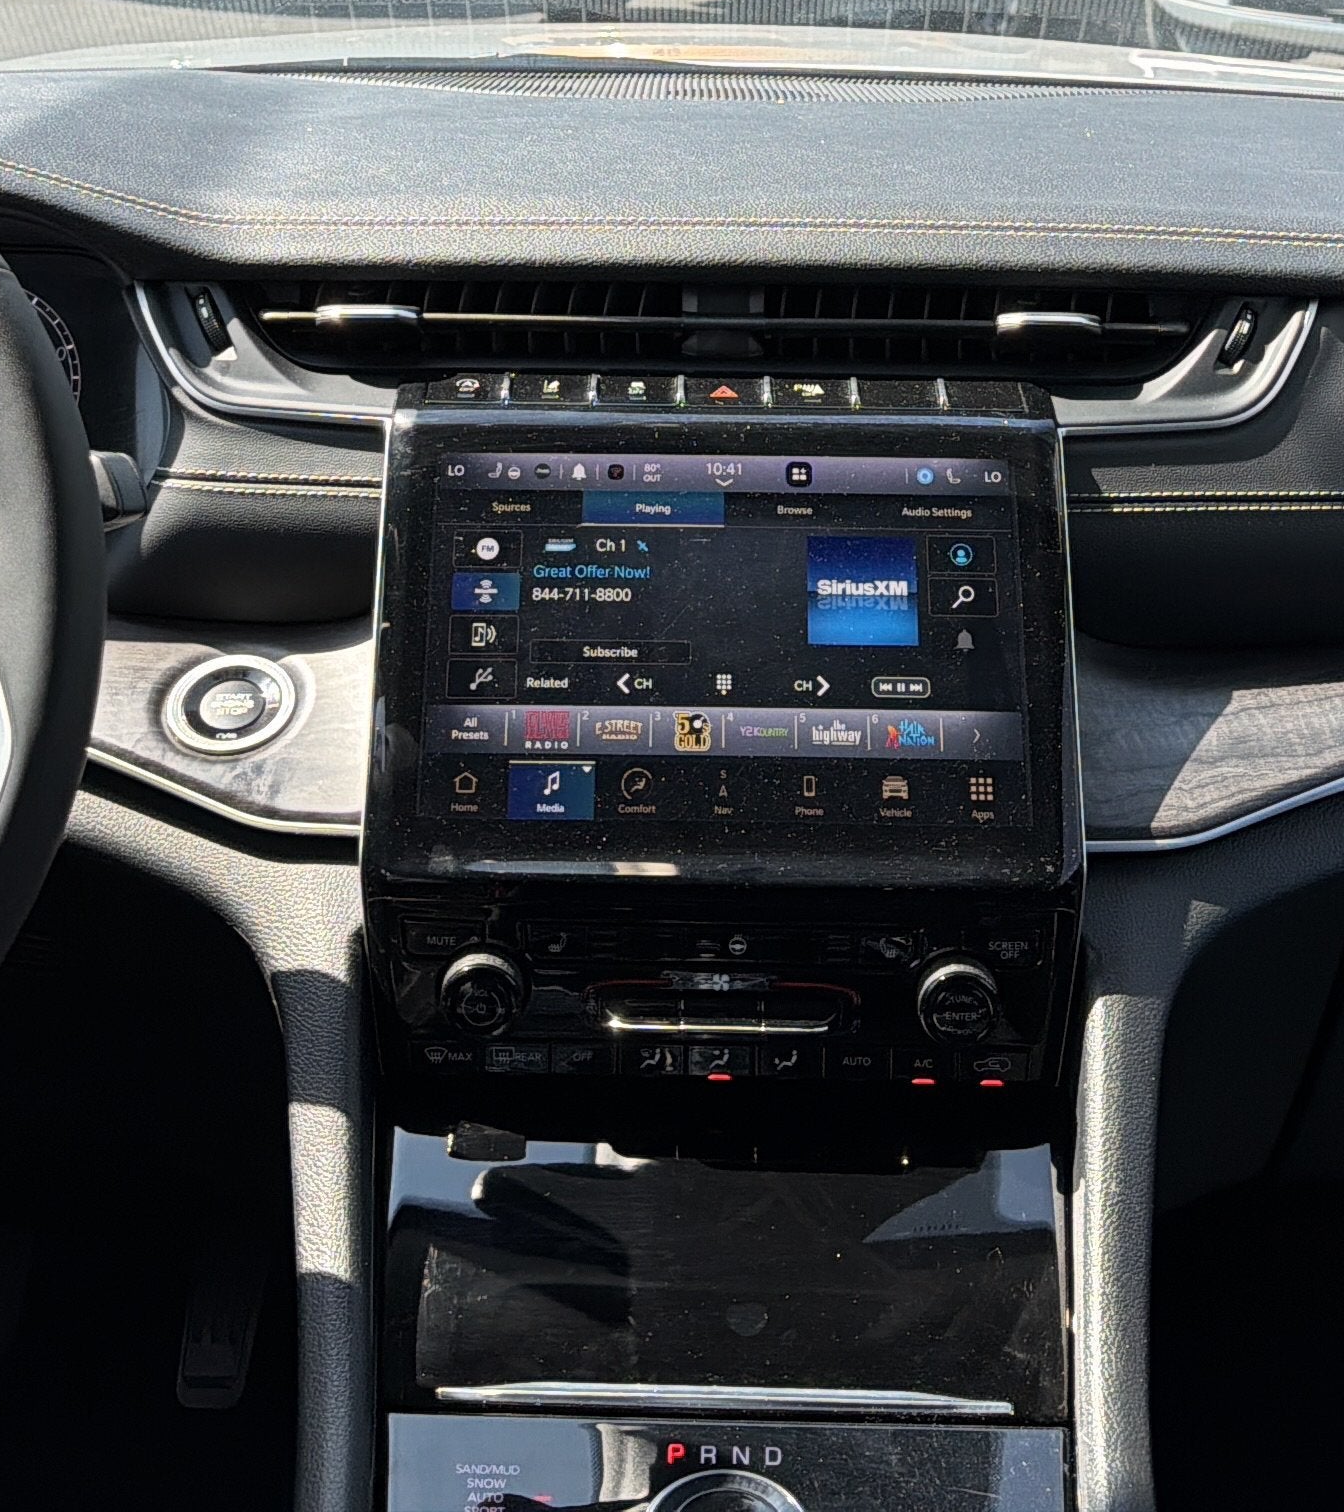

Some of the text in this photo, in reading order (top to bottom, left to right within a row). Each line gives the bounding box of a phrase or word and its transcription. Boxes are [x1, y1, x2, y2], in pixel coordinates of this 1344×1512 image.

[447, 465, 465, 477] LO
[706, 462, 743, 476] 10:41
[643, 474, 662, 483] OUT
[984, 471, 1002, 483] LO
[492, 502, 531, 513] Sources
[635, 503, 671, 515] Playing
[777, 505, 813, 516] Browse
[901, 507, 973, 519] Audio Settings
[481, 545, 495, 553] FM
[596, 538, 626, 552] Ch 1
[533, 565, 651, 578] Great Offer Now!
[816, 580, 908, 596] SiriusXM
[532, 588, 632, 602] 844-711-8800
[582, 646, 638, 657] Subscribe
[526, 677, 569, 688] Related
[634, 678, 653, 690] CH
[794, 680, 813, 692] CH
[511, 710, 517, 720] 1
[582, 710, 590, 721] 2
[654, 711, 662, 721] 3
[726, 712, 734, 722] 4
[799, 713, 806, 723] 5
[872, 714, 879, 724] 6
[463, 717, 478, 728] All
[595, 719, 643, 735] E STREET
[833, 719, 846, 731] the
[451, 729, 490, 741] Presets
[812, 725, 862, 746] highway
[899, 734, 935, 747] NATION
[524, 741, 569, 750] RADIO
[676, 734, 709, 749] GOLD
[451, 803, 479, 813] Home
[536, 803, 565, 814] Media
[618, 803, 657, 814] Comfort
[714, 806, 733, 815] Nav
[795, 806, 825, 817] Phone
[879, 807, 913, 818] Vehicle
[971, 809, 995, 821] Apps
[427, 936, 456, 945] MUTE
[988, 941, 1029, 950] SCREEN
[1000, 950, 1020, 959] OFF
[945, 1012, 978, 1021] ENTER
[448, 1052, 473, 1061] MAX
[515, 1052, 542, 1061] REAR
[573, 1052, 593, 1062] OFF
[842, 1056, 872, 1066] AUTO
[914, 1059, 934, 1068] A/C
[667, 1443, 685, 1465] P
[700, 1445, 717, 1465] R
[733, 1446, 750, 1465] N
[765, 1446, 782, 1466] D
[456, 1464, 520, 1475] SAND/MUD
[466, 1478, 507, 1489] SNOW
[467, 1492, 505, 1503] AUTO
